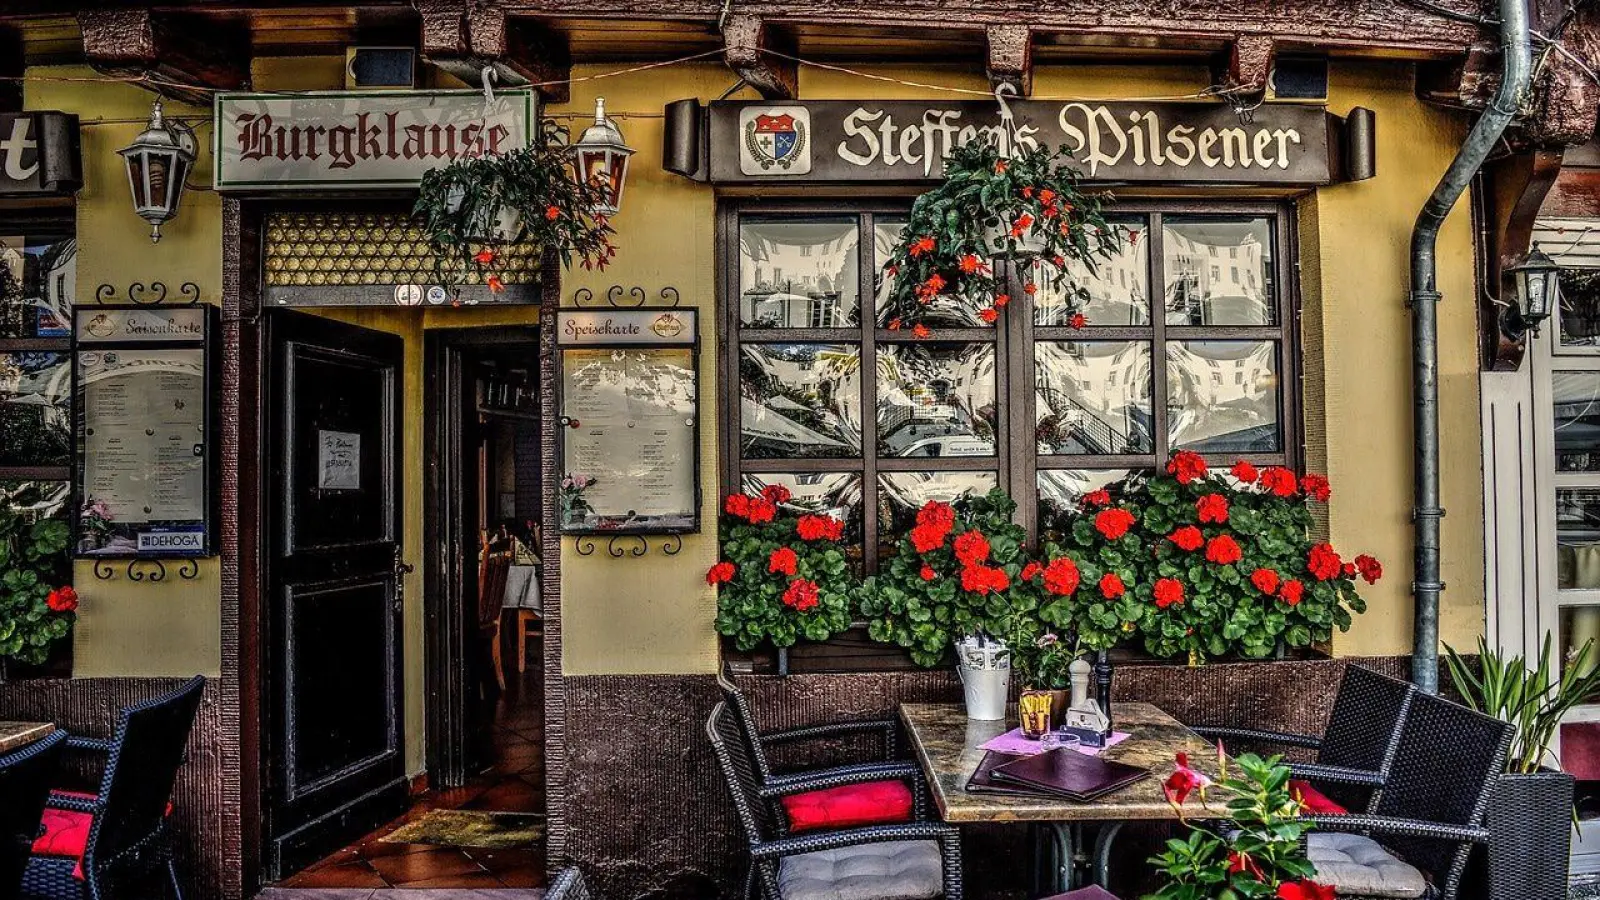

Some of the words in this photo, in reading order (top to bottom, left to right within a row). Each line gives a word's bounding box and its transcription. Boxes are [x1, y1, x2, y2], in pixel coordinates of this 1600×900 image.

[235, 110, 510, 169] Burgklause
[1059, 102, 1302, 177] Pilsener
[564, 319, 640, 341] Speisekarte
[151, 535, 200, 547] DEHOGA
